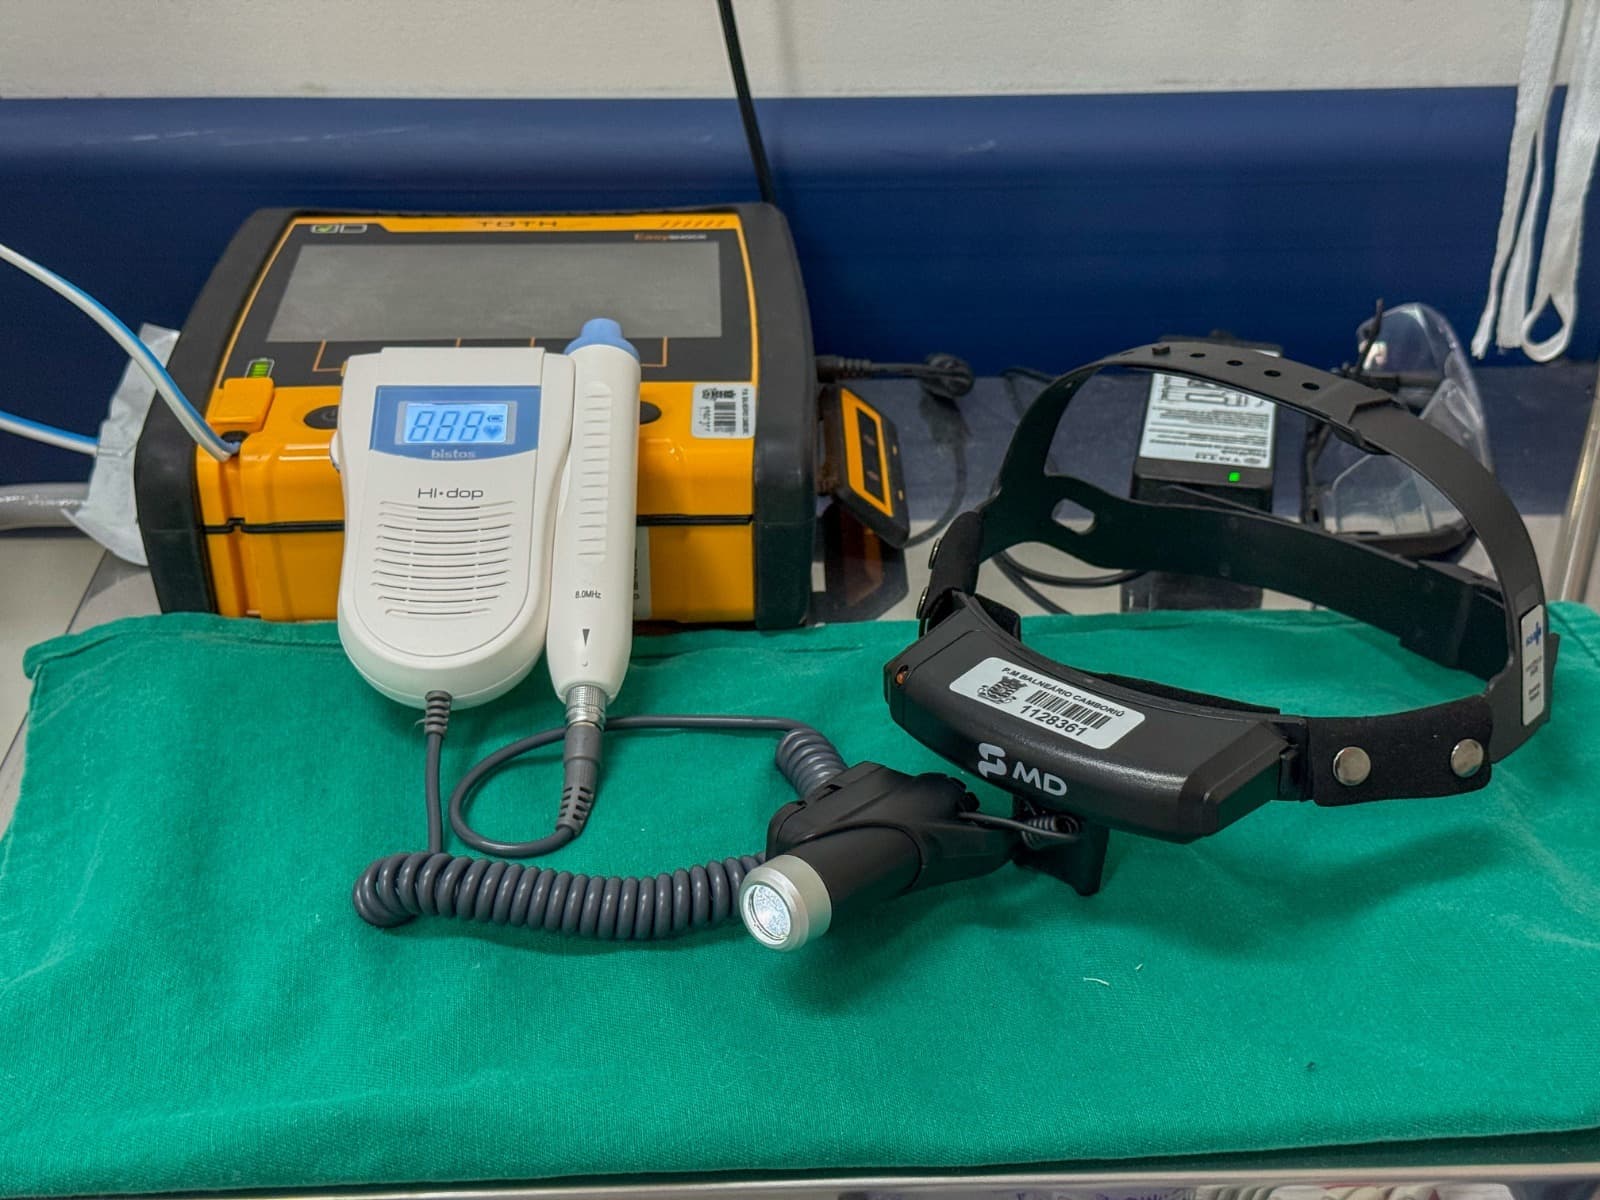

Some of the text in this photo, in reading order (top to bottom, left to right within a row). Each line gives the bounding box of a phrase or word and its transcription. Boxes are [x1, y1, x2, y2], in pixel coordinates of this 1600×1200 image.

[479, 219, 559, 228] TOTH
[431, 449, 477, 460] bistos
[1002, 666, 1126, 718] P.M BALNEÁRIO CAMBORIÚ
[1019, 705, 1089, 737] 1128361
[1012, 761, 1068, 797] MD
